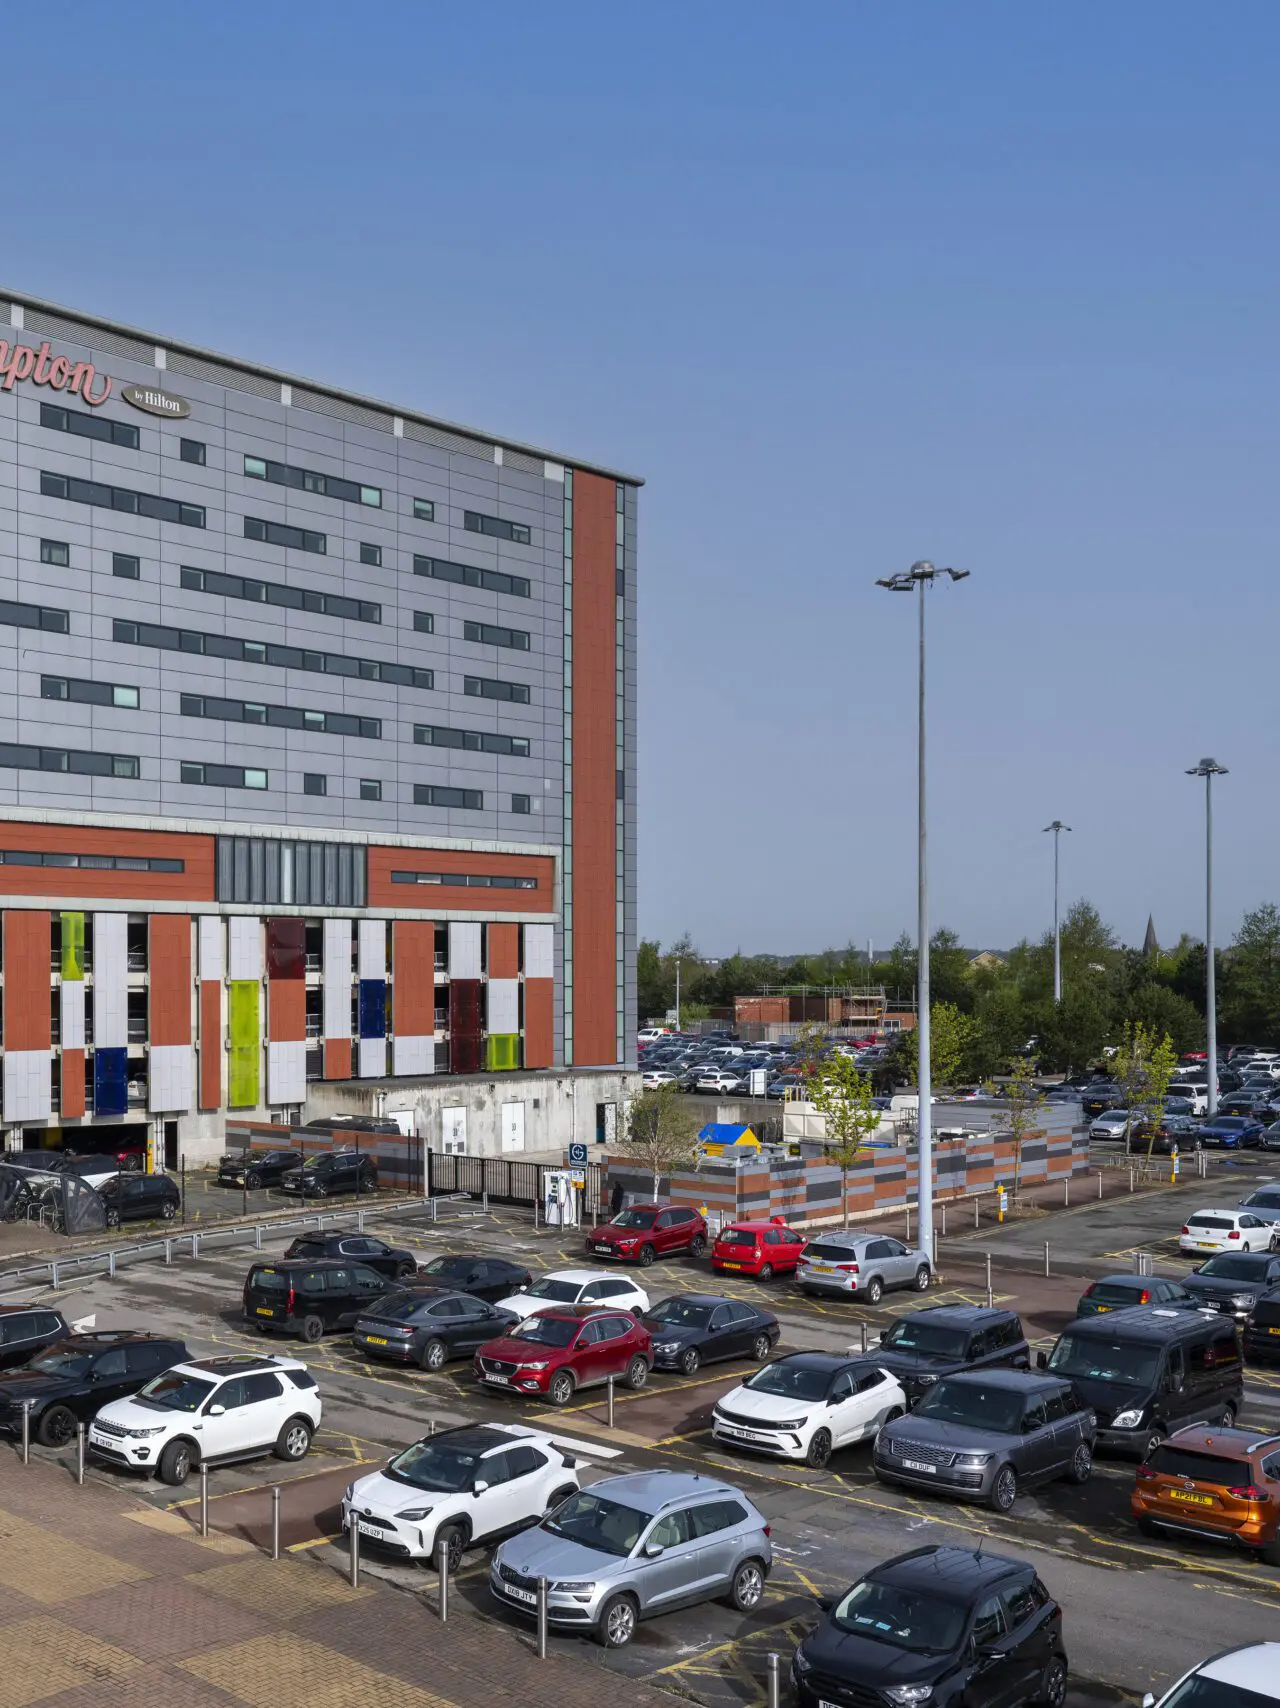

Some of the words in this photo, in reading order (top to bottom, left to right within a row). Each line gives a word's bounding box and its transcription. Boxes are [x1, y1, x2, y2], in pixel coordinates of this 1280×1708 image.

[135, 390, 144, 402] by
[145, 391, 180, 412] Hilton
[520, 1591, 533, 1601] JTY
